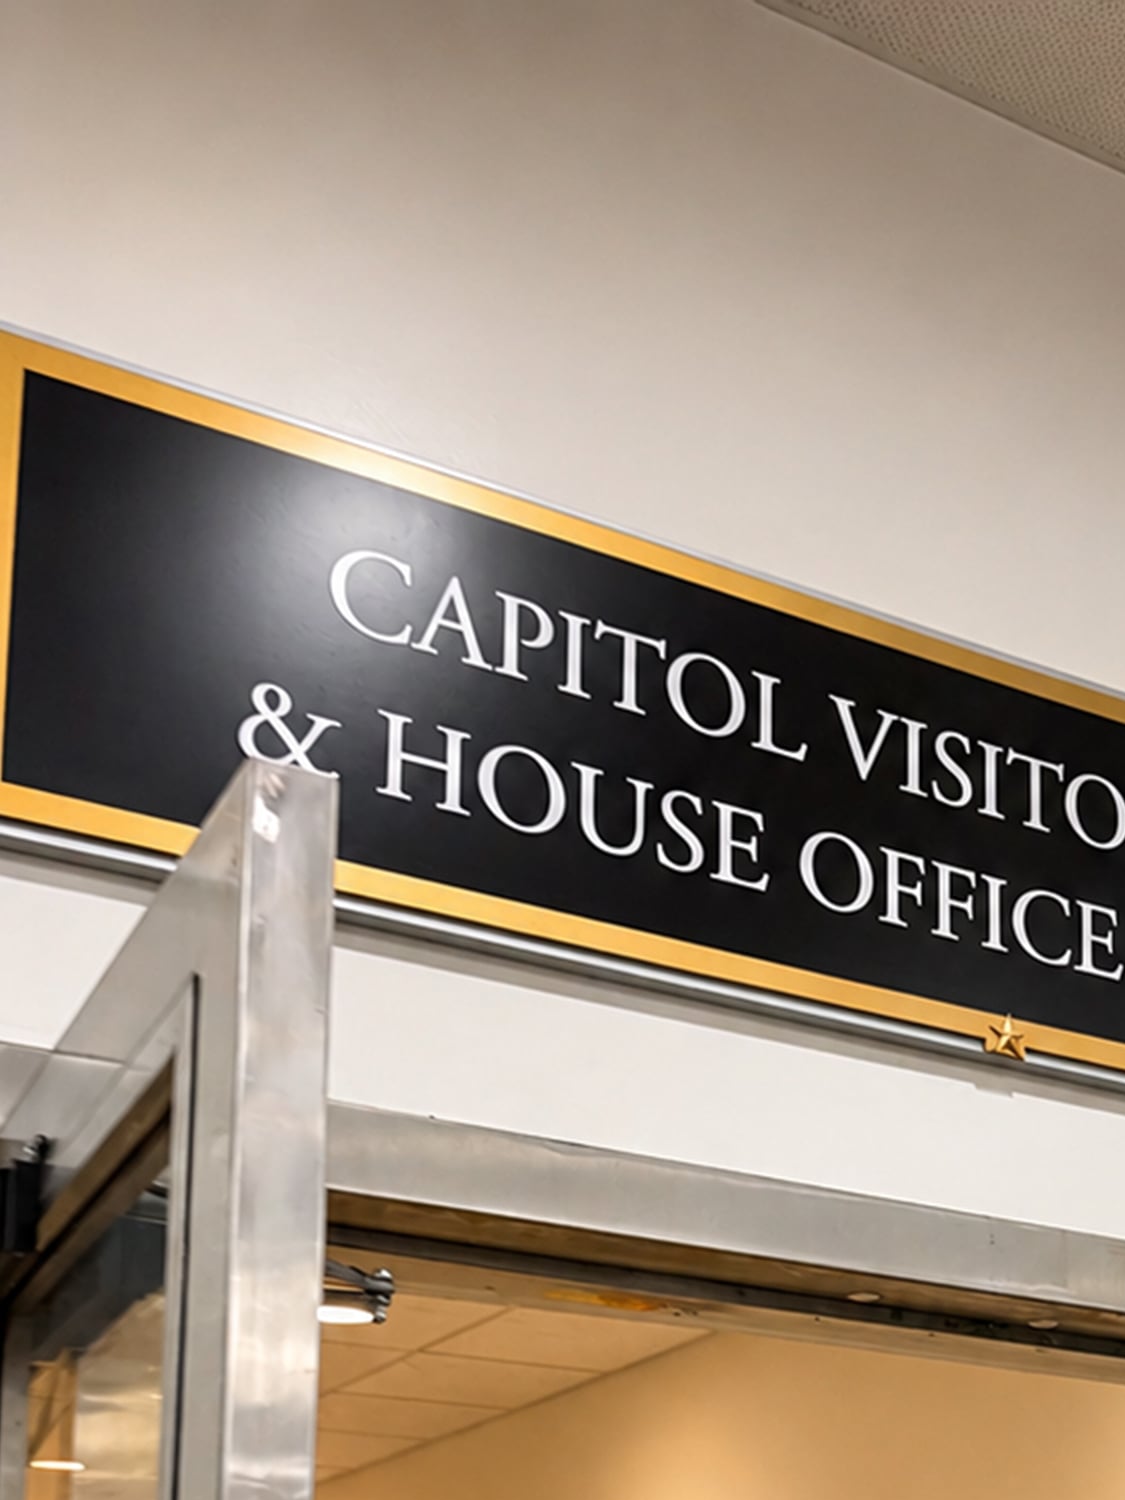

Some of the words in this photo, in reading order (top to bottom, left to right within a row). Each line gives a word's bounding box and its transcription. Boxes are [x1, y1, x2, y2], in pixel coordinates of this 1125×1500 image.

[329, 549, 809, 762] CAPITOL
[236, 683, 343, 780] &
[376, 708, 771, 893] HOUSE
[800, 831, 1124, 981] OFFICE
